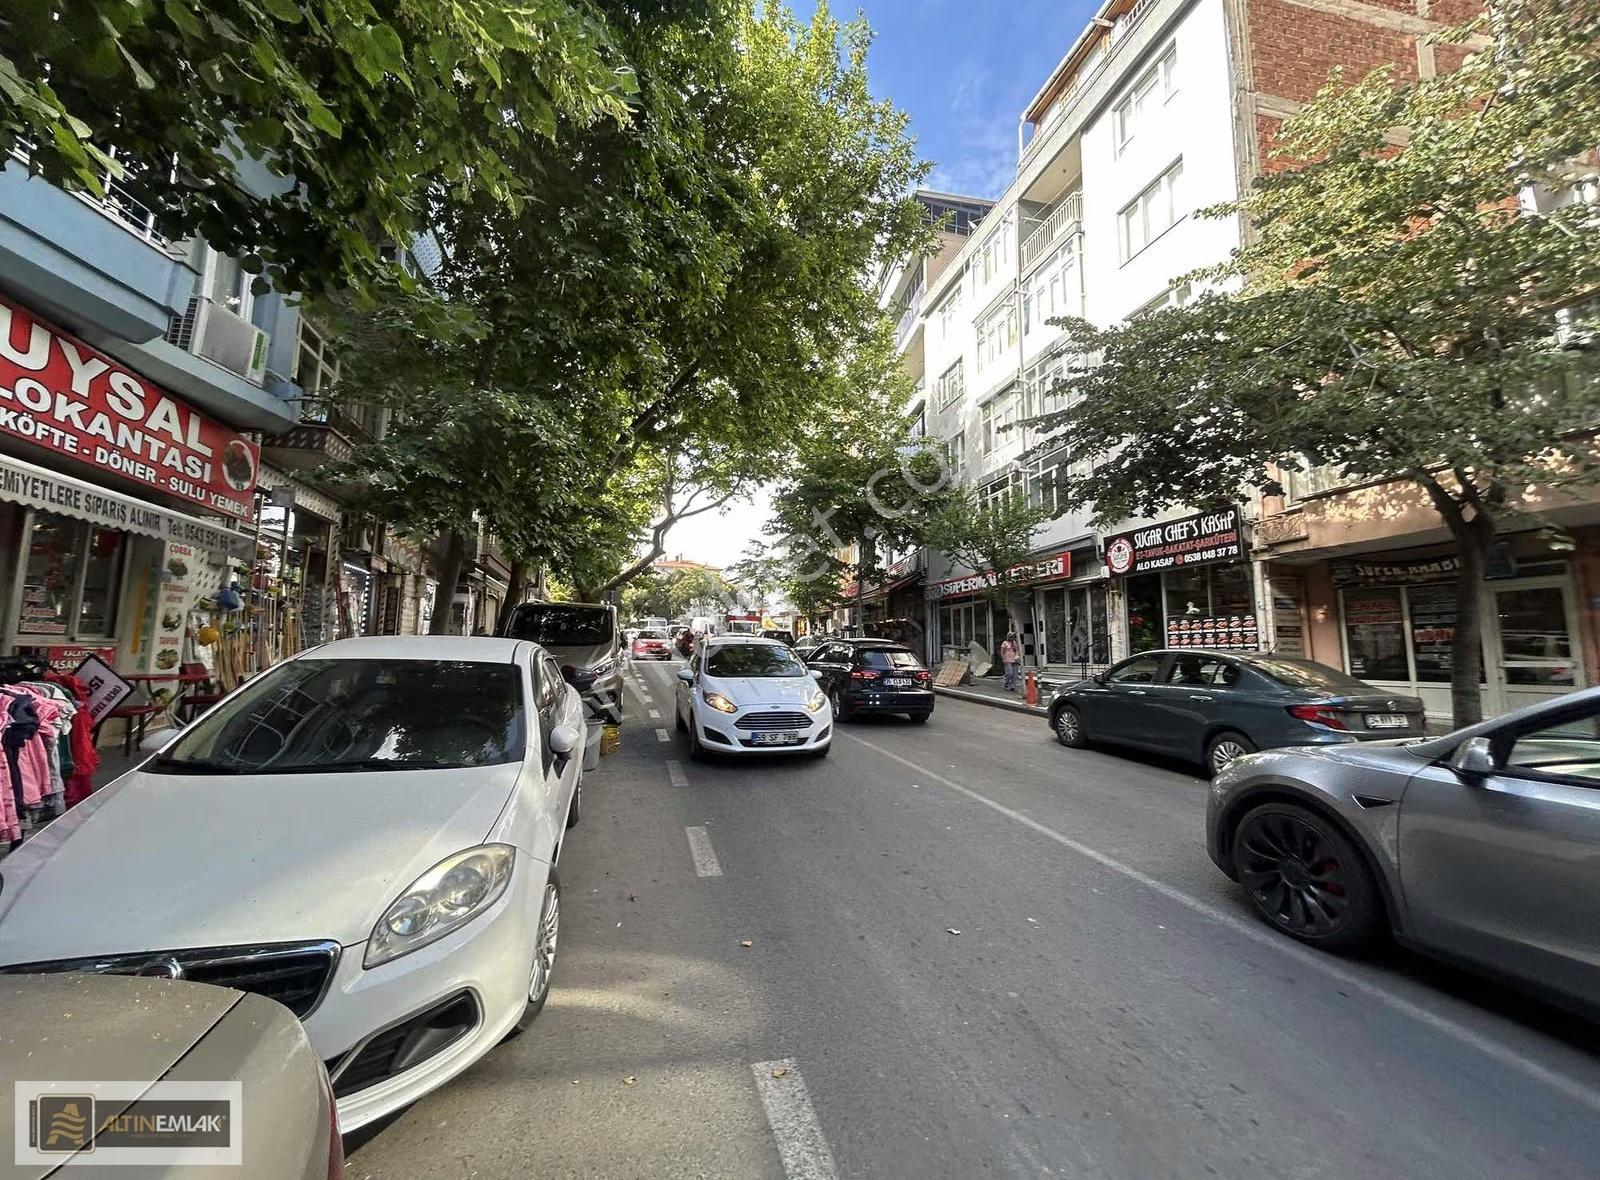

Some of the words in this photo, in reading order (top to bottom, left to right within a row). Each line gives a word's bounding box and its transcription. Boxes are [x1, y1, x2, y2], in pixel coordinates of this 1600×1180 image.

[0, 302, 212, 457] UYSAL
[0, 406, 79, 453] KÖFTE
[96, 446, 156, 483] DÖNER
[169, 477, 205, 501] SULU
[209, 491, 248, 517] YEMEK
[1134, 527, 1163, 549] SUGAR
[1164, 519, 1198, 542] CHEF'S
[1200, 510, 1235, 536] KASAP
[944, 557, 1064, 596] SÜPERMEERİ
[1136, 562, 1150, 572] ALO
[1150, 557, 1174, 569] KASAP
[1184, 552, 1201, 564] 0538
[1216, 548, 1227, 558] 37
[1227, 545, 1239, 556] 78
